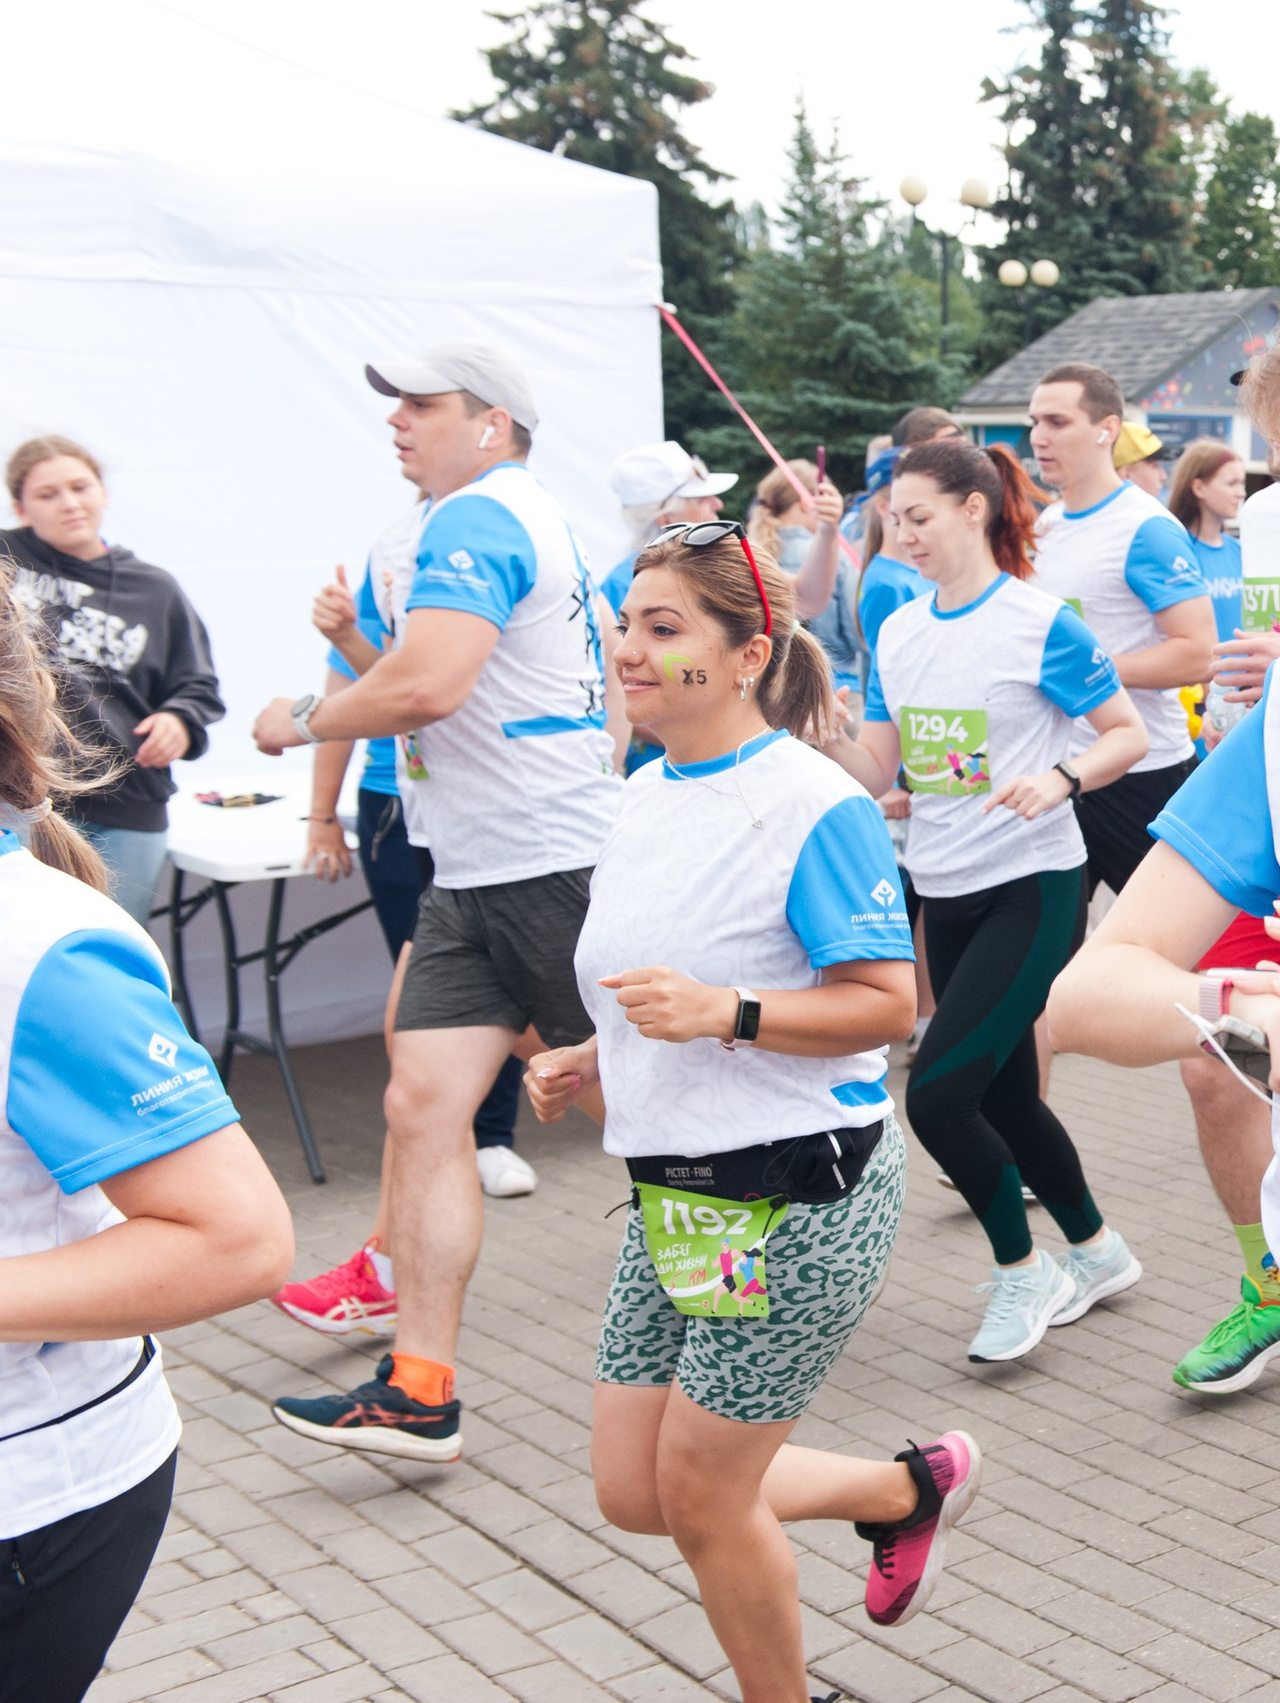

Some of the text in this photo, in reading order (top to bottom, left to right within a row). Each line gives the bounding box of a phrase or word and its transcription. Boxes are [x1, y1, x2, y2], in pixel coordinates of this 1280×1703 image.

[682, 669, 707, 685] X5
[908, 713, 969, 744] 1294
[851, 912, 885, 924] ЛИНИЯ
[131, 1074, 183, 1107] ЛИНИЯ
[661, 1198, 753, 1236] 1192
[657, 1243, 692, 1261] ЗАБЕГ
